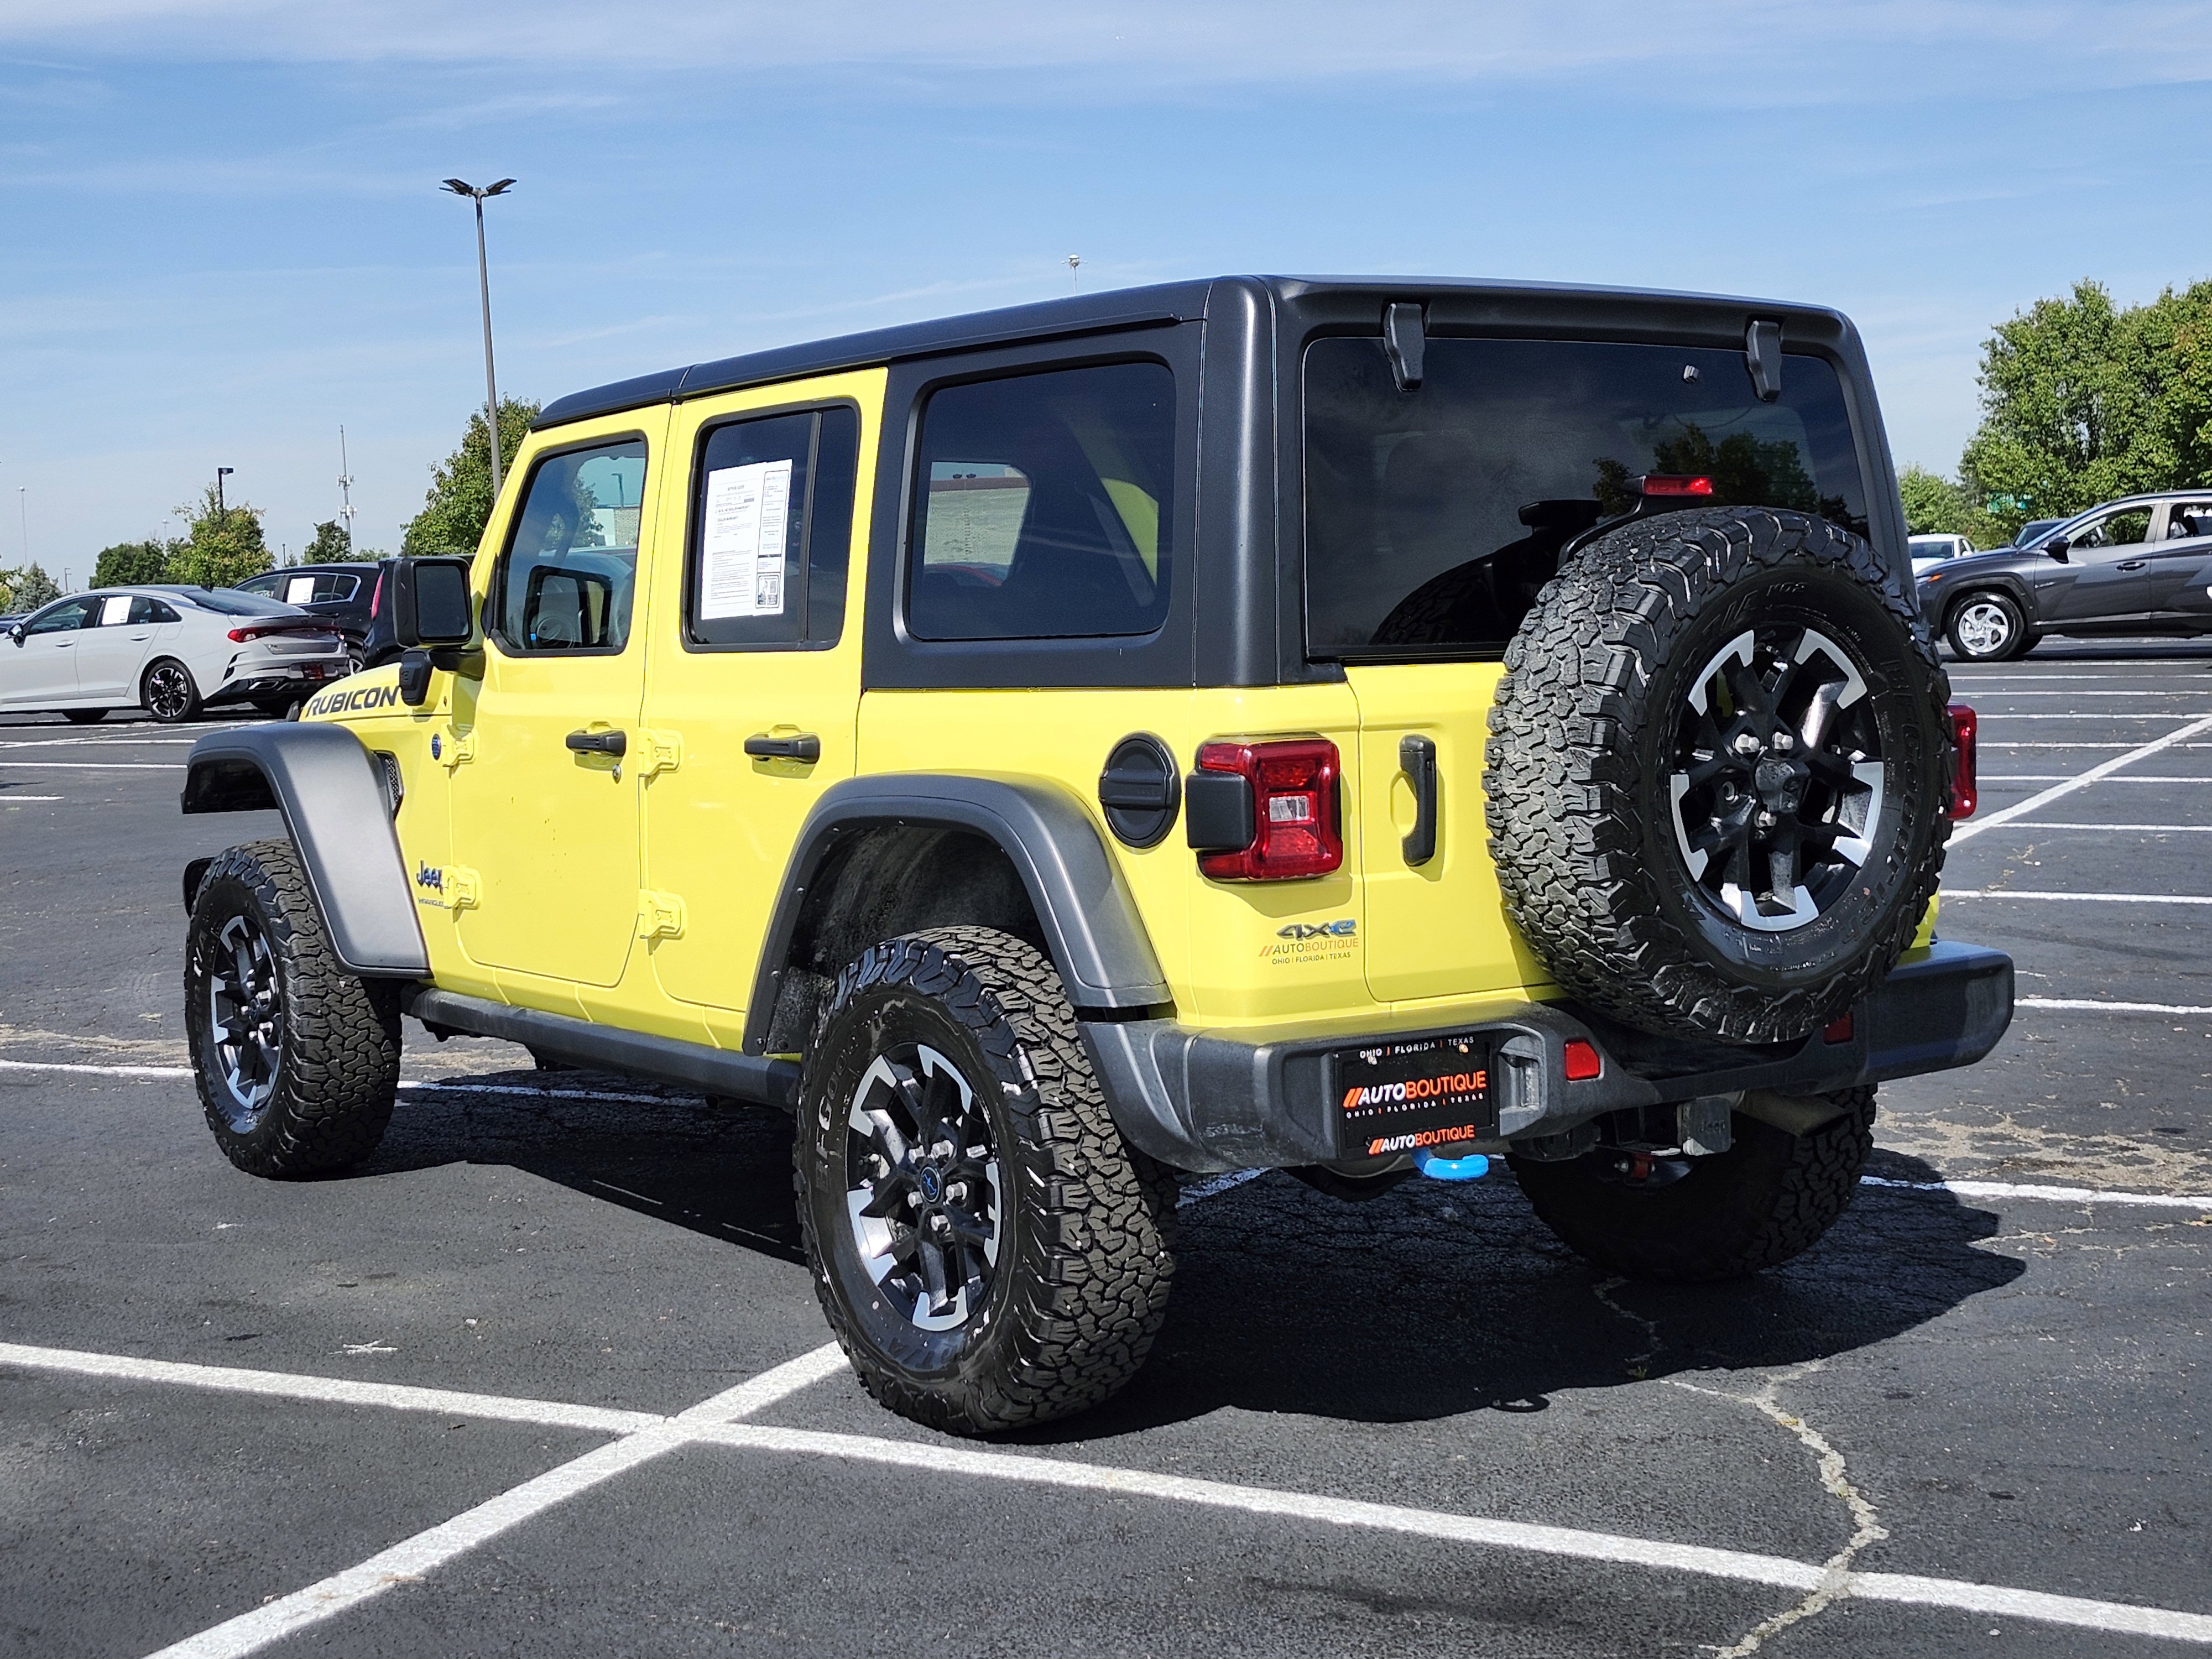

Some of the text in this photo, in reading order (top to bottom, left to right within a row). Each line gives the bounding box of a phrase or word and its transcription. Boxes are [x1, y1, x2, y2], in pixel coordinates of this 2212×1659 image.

[305, 685, 400, 718] RUBICON
[1271, 951, 1352, 965] OHIO FLORIDA TEXAS
[1359, 1036, 1474, 1060] OHIO FLORIDA TEXAS
[1345, 1092, 1484, 1119] OHIO FLORIDA TEXAS
